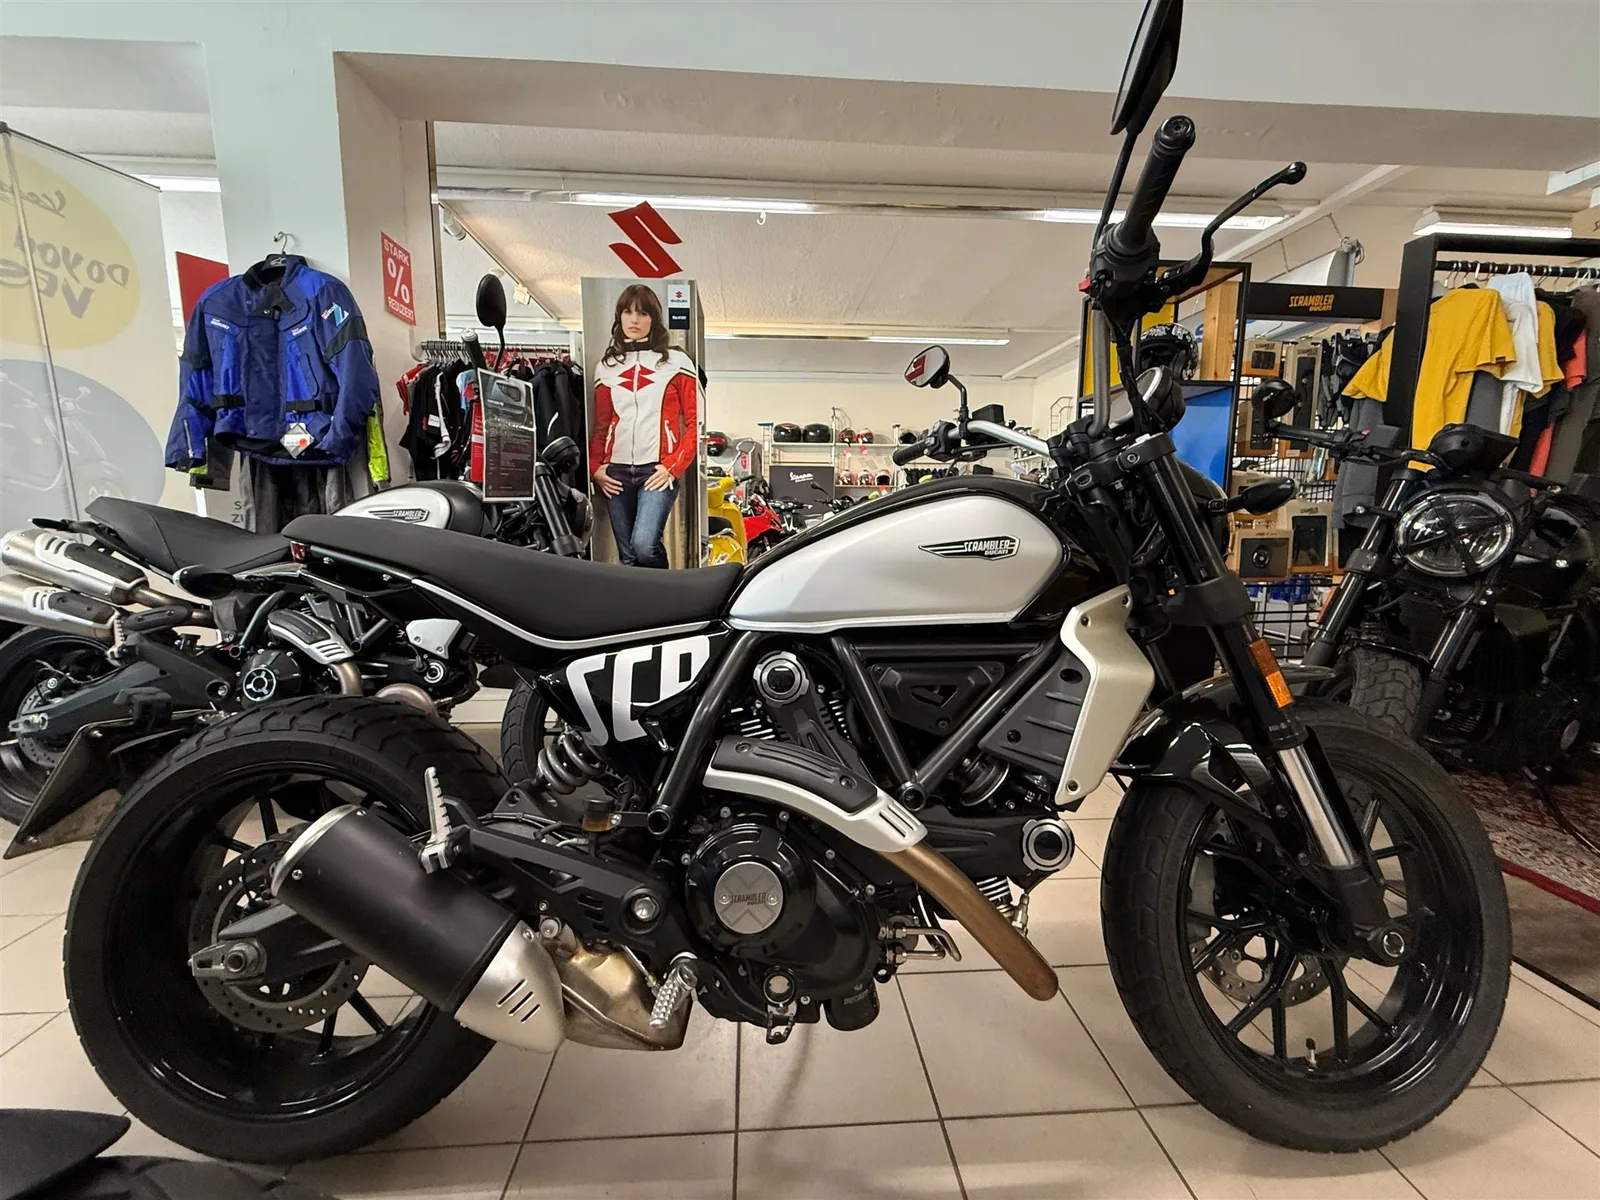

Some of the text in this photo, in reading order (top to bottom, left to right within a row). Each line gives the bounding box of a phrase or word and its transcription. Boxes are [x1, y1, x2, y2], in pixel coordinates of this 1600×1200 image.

[383, 238, 410, 266] STARK
[387, 257, 410, 304] %
[1289, 294, 1335, 307] SCRAMBLER
[393, 509, 422, 518] SCRAMBLER
[963, 540, 1010, 552] SCRAMBLER
